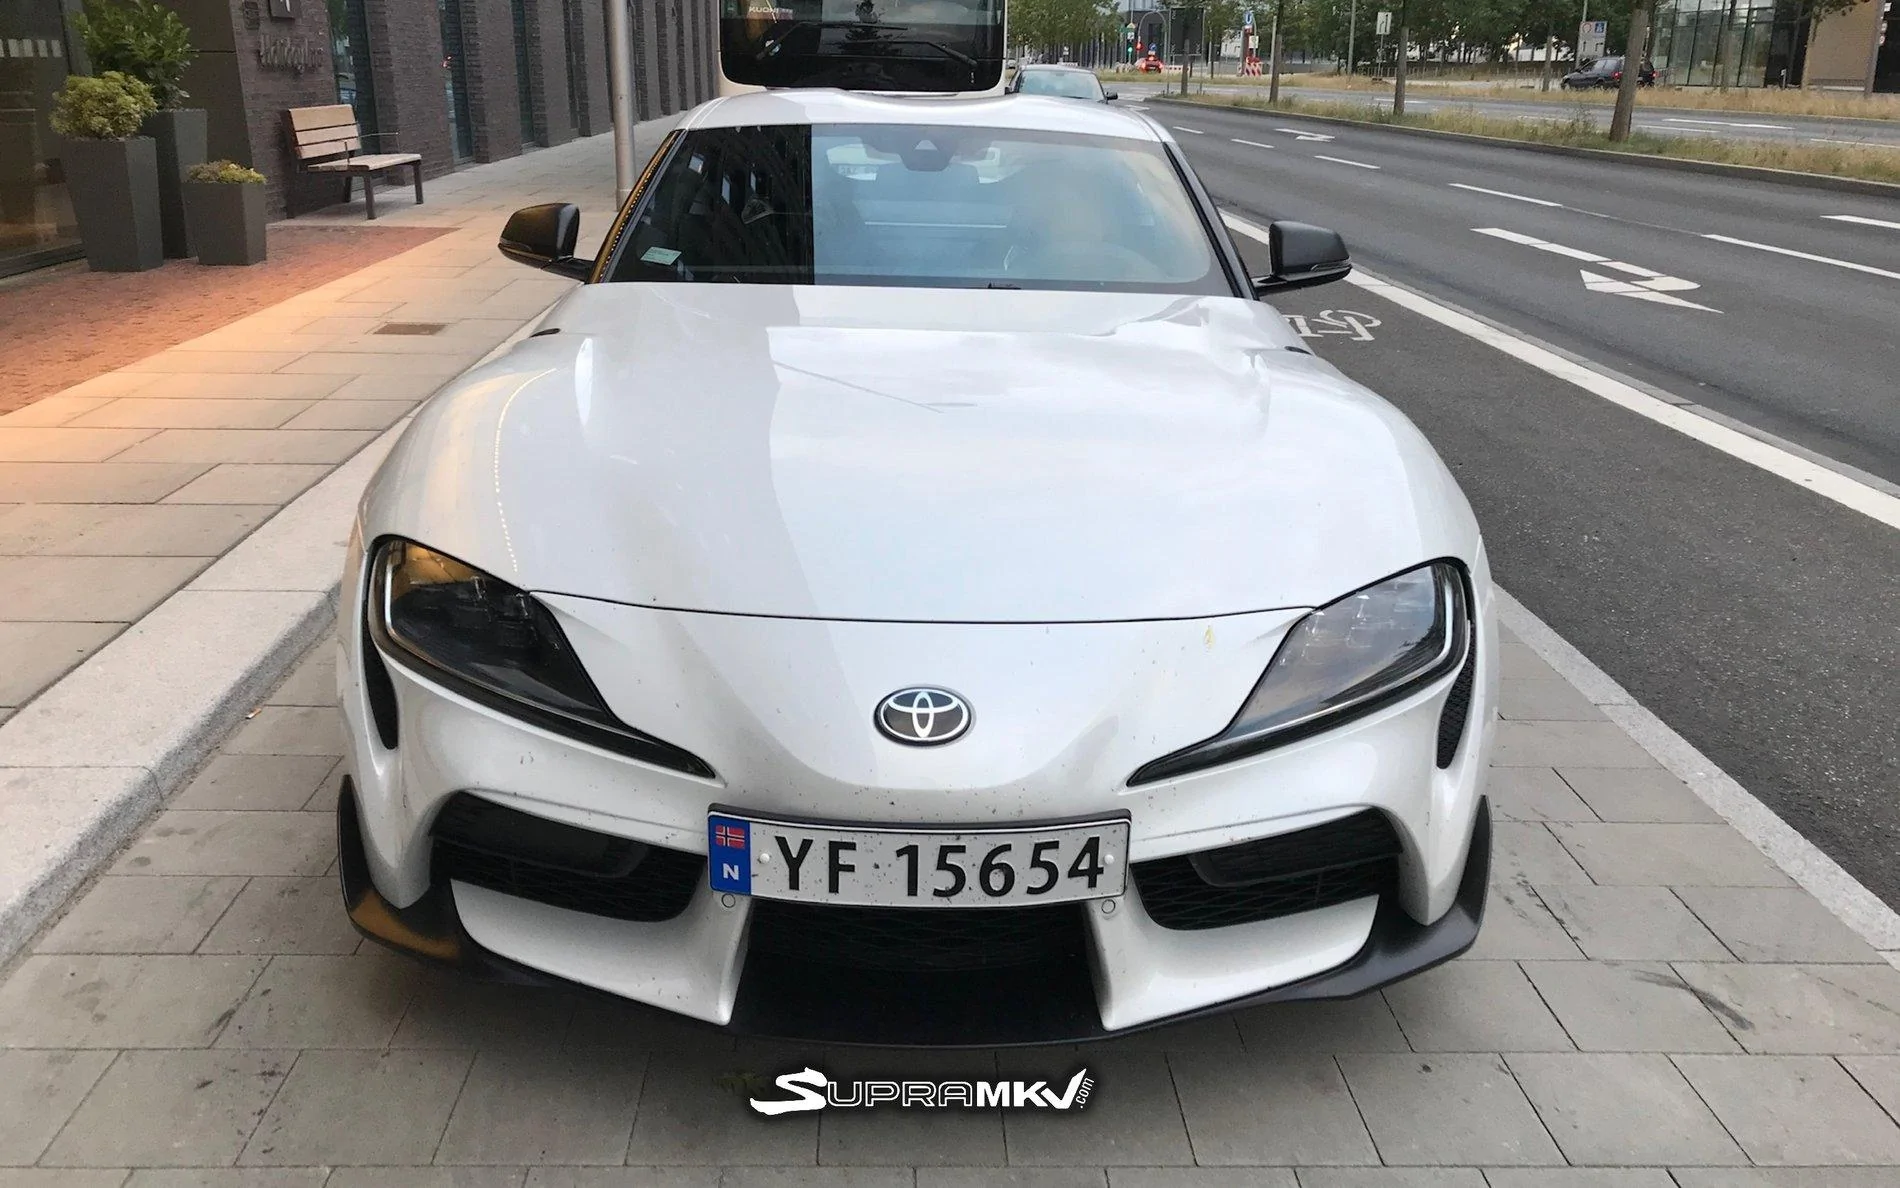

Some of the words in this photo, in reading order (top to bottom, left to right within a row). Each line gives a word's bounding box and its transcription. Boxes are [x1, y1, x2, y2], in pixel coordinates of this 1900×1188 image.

[722, 864, 739, 880] N
[774, 836, 857, 895] YF
[895, 836, 1104, 898] 15654
